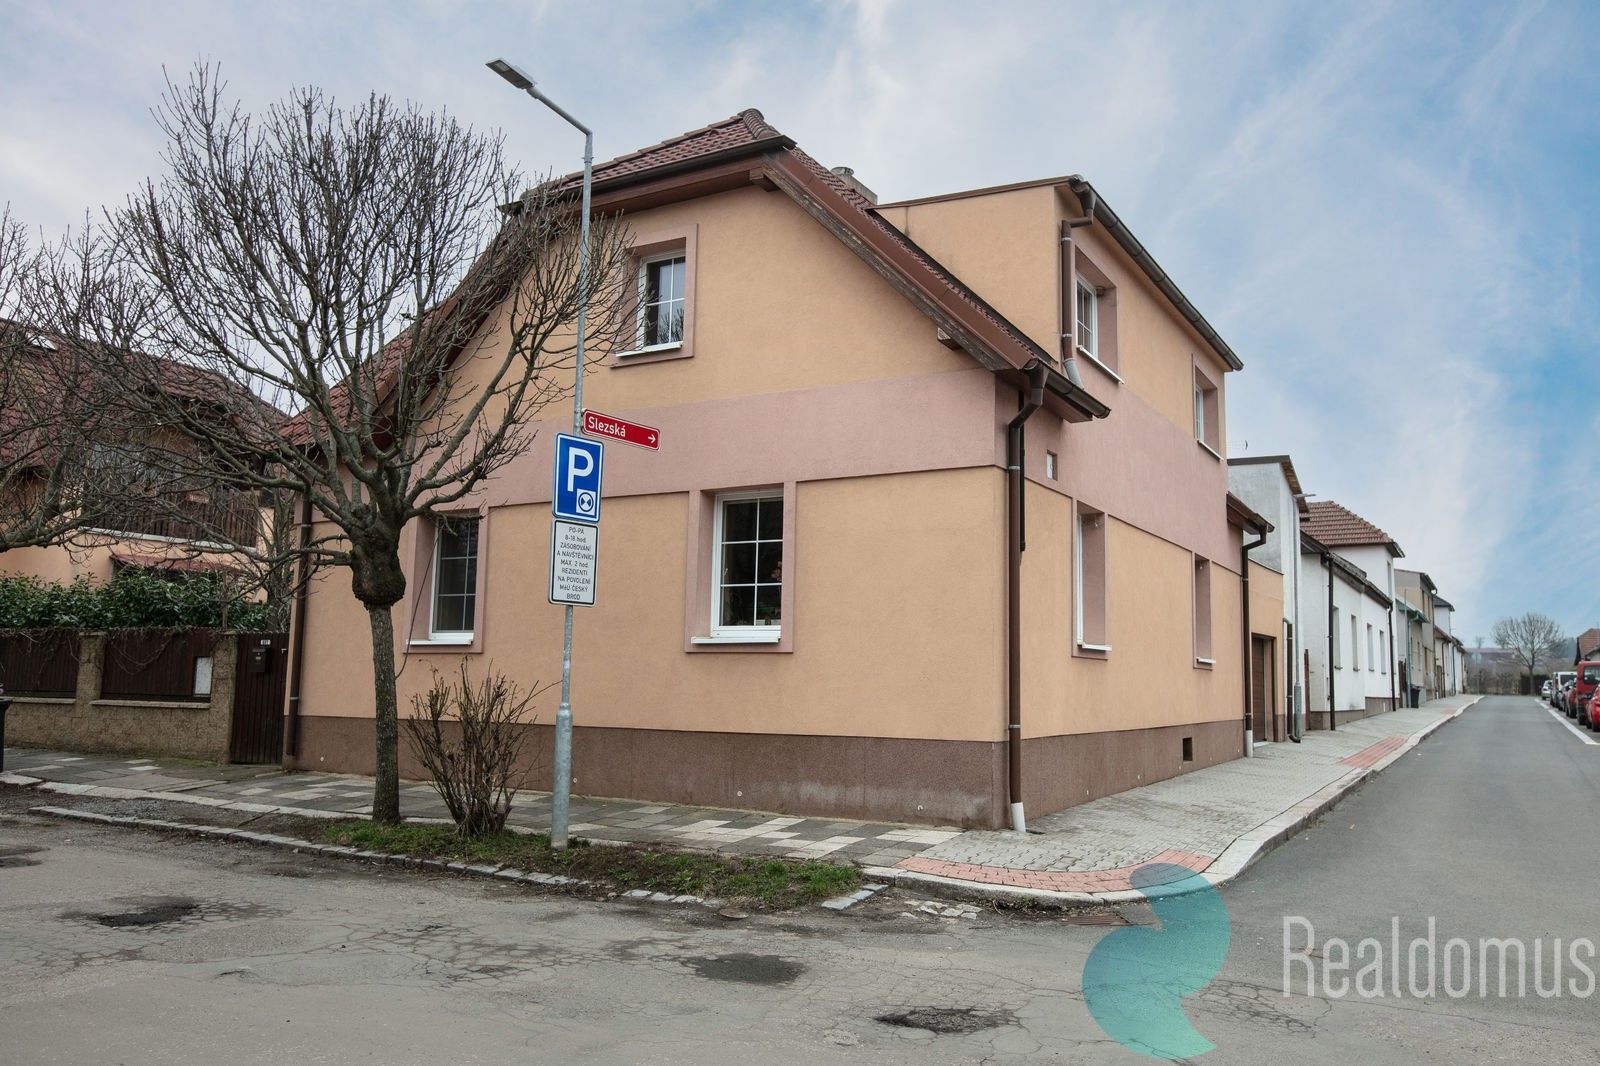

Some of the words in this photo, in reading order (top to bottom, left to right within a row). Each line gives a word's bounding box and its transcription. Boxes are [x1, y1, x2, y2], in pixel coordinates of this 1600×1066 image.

[588, 416, 626, 437] Slezská
[567, 446, 594, 492] P
[561, 568, 588, 576] REZIDENTI
